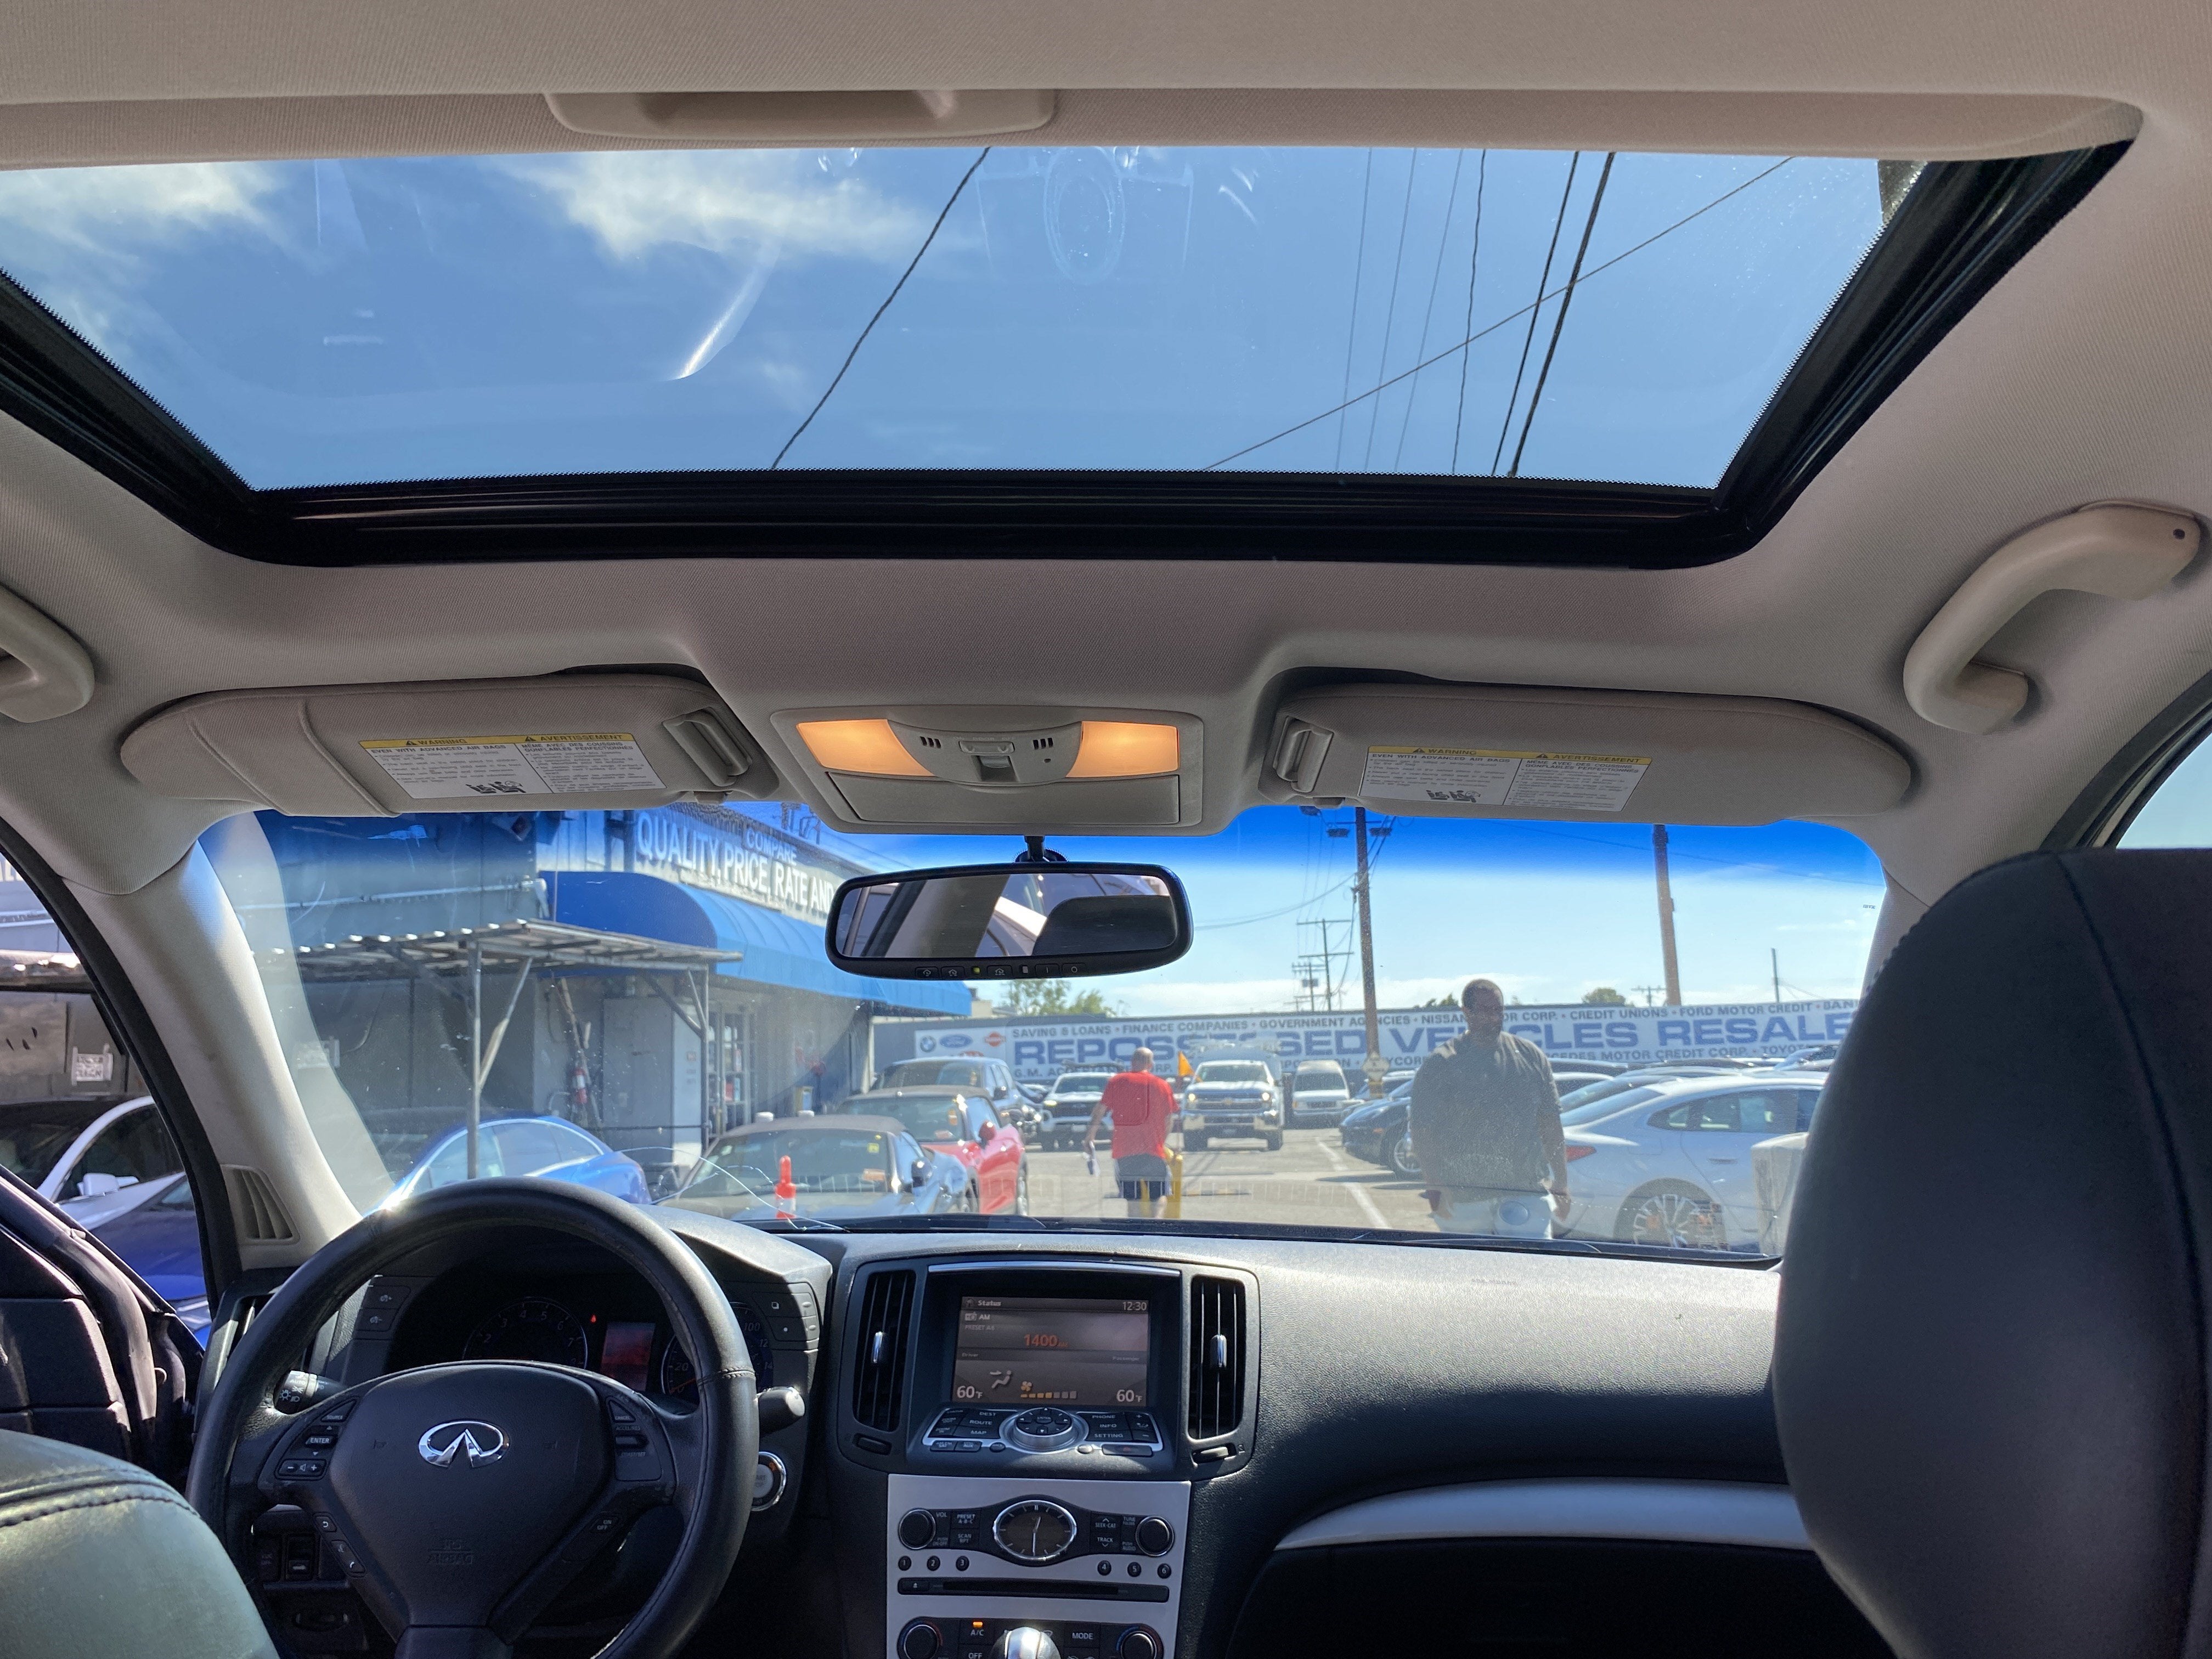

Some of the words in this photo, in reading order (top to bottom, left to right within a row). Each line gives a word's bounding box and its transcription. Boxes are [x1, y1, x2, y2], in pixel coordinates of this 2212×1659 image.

[1553, 754, 1640, 763] AVERTISSEMENT
[746, 827, 797, 866] COMPARE
[775, 861, 808, 905] RATE
[810, 876, 834, 916] AND
[1013, 1026, 1057, 1037] SAVING
[1071, 1025, 1111, 1035] LOANS
[1122, 1023, 1174, 1034] FINANCE
[1177, 1020, 1248, 1032] COMPANIES
[1259, 1017, 1344, 1029] GOVERNMENT
[1570, 1010, 1616, 1020] CREDIT
[1620, 1008, 1668, 1019] UNIONS
[1679, 1006, 1713, 1018] FORD
[1718, 1005, 1764, 1015] MOTOR
[1768, 1002, 1812, 1013] CREDIT
[1601, 1049, 1650, 1060] MOTOR
[1655, 1048, 1702, 1060] CREDIT
[1122, 1301, 1147, 1311] 12:30
[743, 1322, 761, 1332] 100
[1024, 1334, 1059, 1347] 1400
